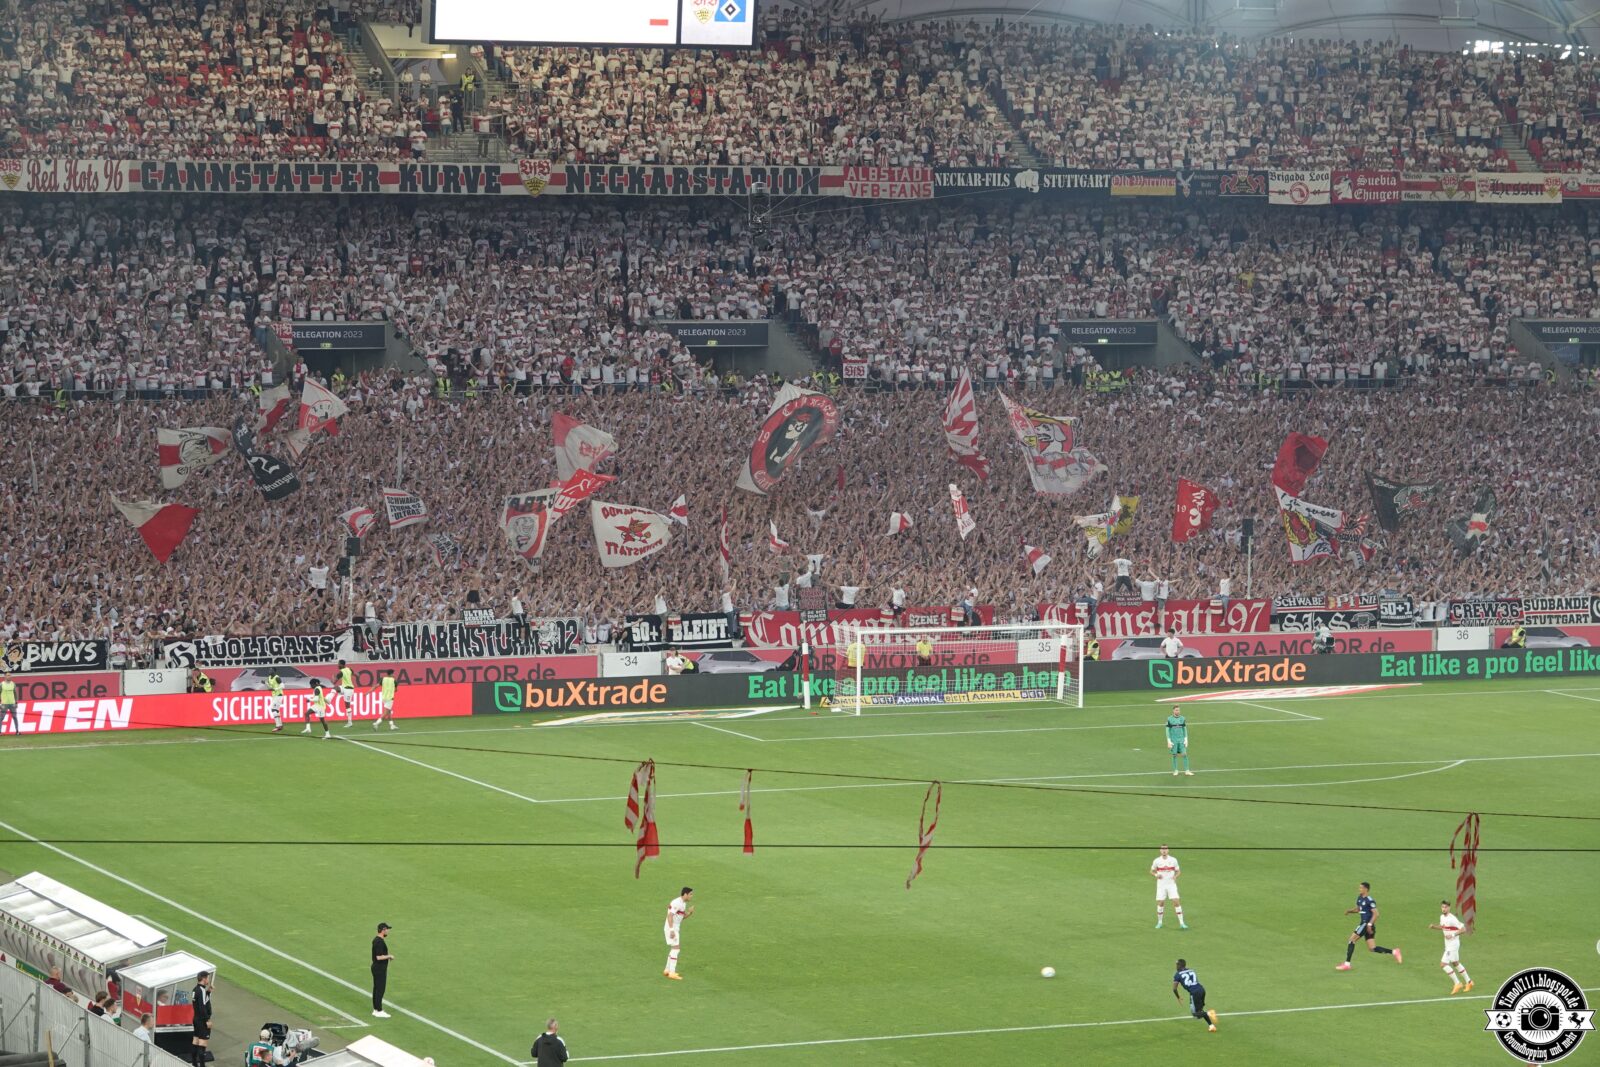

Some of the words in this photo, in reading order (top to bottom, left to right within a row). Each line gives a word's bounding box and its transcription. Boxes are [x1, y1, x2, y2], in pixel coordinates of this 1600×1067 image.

[27, 158, 59, 191] Red
[63, 160, 98, 192] Hots
[103, 160, 123, 191] 96
[140, 163, 380, 192] CANNSTATTER
[400, 164, 500, 193] KURVE
[565, 164, 820, 196] NECKARSTADION
[848, 167, 932, 182] ALBSTADT
[934, 172, 1011, 188] NECKAR-FILS
[1043, 173, 1111, 188] STUTTGART
[1269, 172, 1305, 183] Brigada
[1309, 172, 1330, 182] Loca
[1356, 175, 1397, 187] Suebia
[849, 182, 932, 198] VFB-FANS
[1118, 327, 1137, 335] 2023
[1381, 602, 1412, 616] 50+1
[1453, 602, 1500, 618] CREW
[1500, 602, 1519, 618] 36
[909, 613, 939, 626] SZENE
[1525, 614, 1589, 625] STUTTGART
[1456, 630, 1469, 640] 36
[194, 635, 334, 660] HOOLIGANS
[1038, 642, 1051, 652] 35
[1218, 637, 1395, 657] ORA-MOOR.de
[624, 656, 638, 667] 34
[1381, 655, 1416, 677] Eat
[1421, 653, 1460, 675] like
[1467, 658, 1479, 674] a
[1486, 656, 1519, 679] pro
[1525, 650, 1563, 672] feel
[149, 673, 163, 683] 33
[1177, 658, 1307, 685] buXtrade
[748, 676, 787, 698] Eat
[843, 679, 855, 695] a
[864, 676, 900, 699] pro
[907, 668, 947, 693] feel
[954, 668, 996, 692] like
[1002, 673, 1015, 689] a
[526, 679, 667, 708] buXtrade
[897, 695, 944, 704] ADMIRAL
[972, 692, 1019, 701] ADMIRAL
[1021, 690, 1045, 699] BET
[1181, 971, 1198, 986] 27
